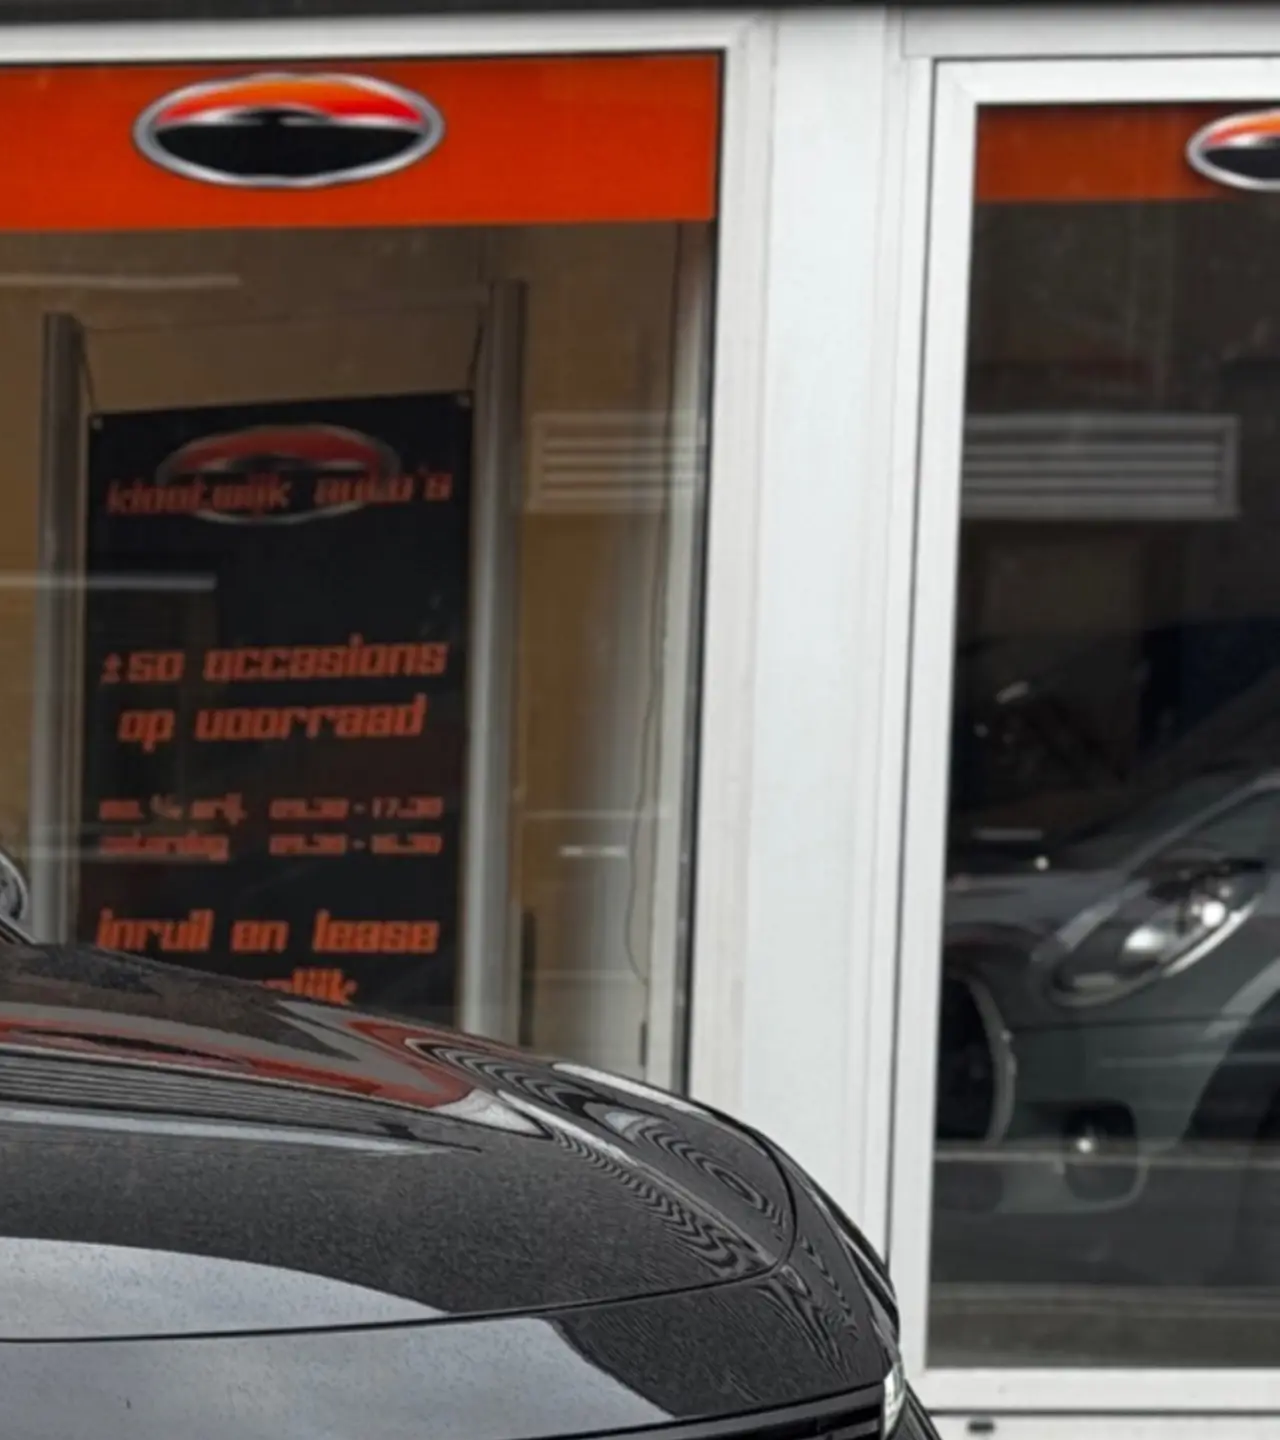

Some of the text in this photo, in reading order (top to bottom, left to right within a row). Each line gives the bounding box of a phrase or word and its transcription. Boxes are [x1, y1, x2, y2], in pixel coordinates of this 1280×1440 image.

[104, 466, 454, 516] klootwijk auto's
[202, 633, 450, 682] occasions
[117, 693, 428, 752] op voorraad
[96, 908, 438, 953] inruil en lease
